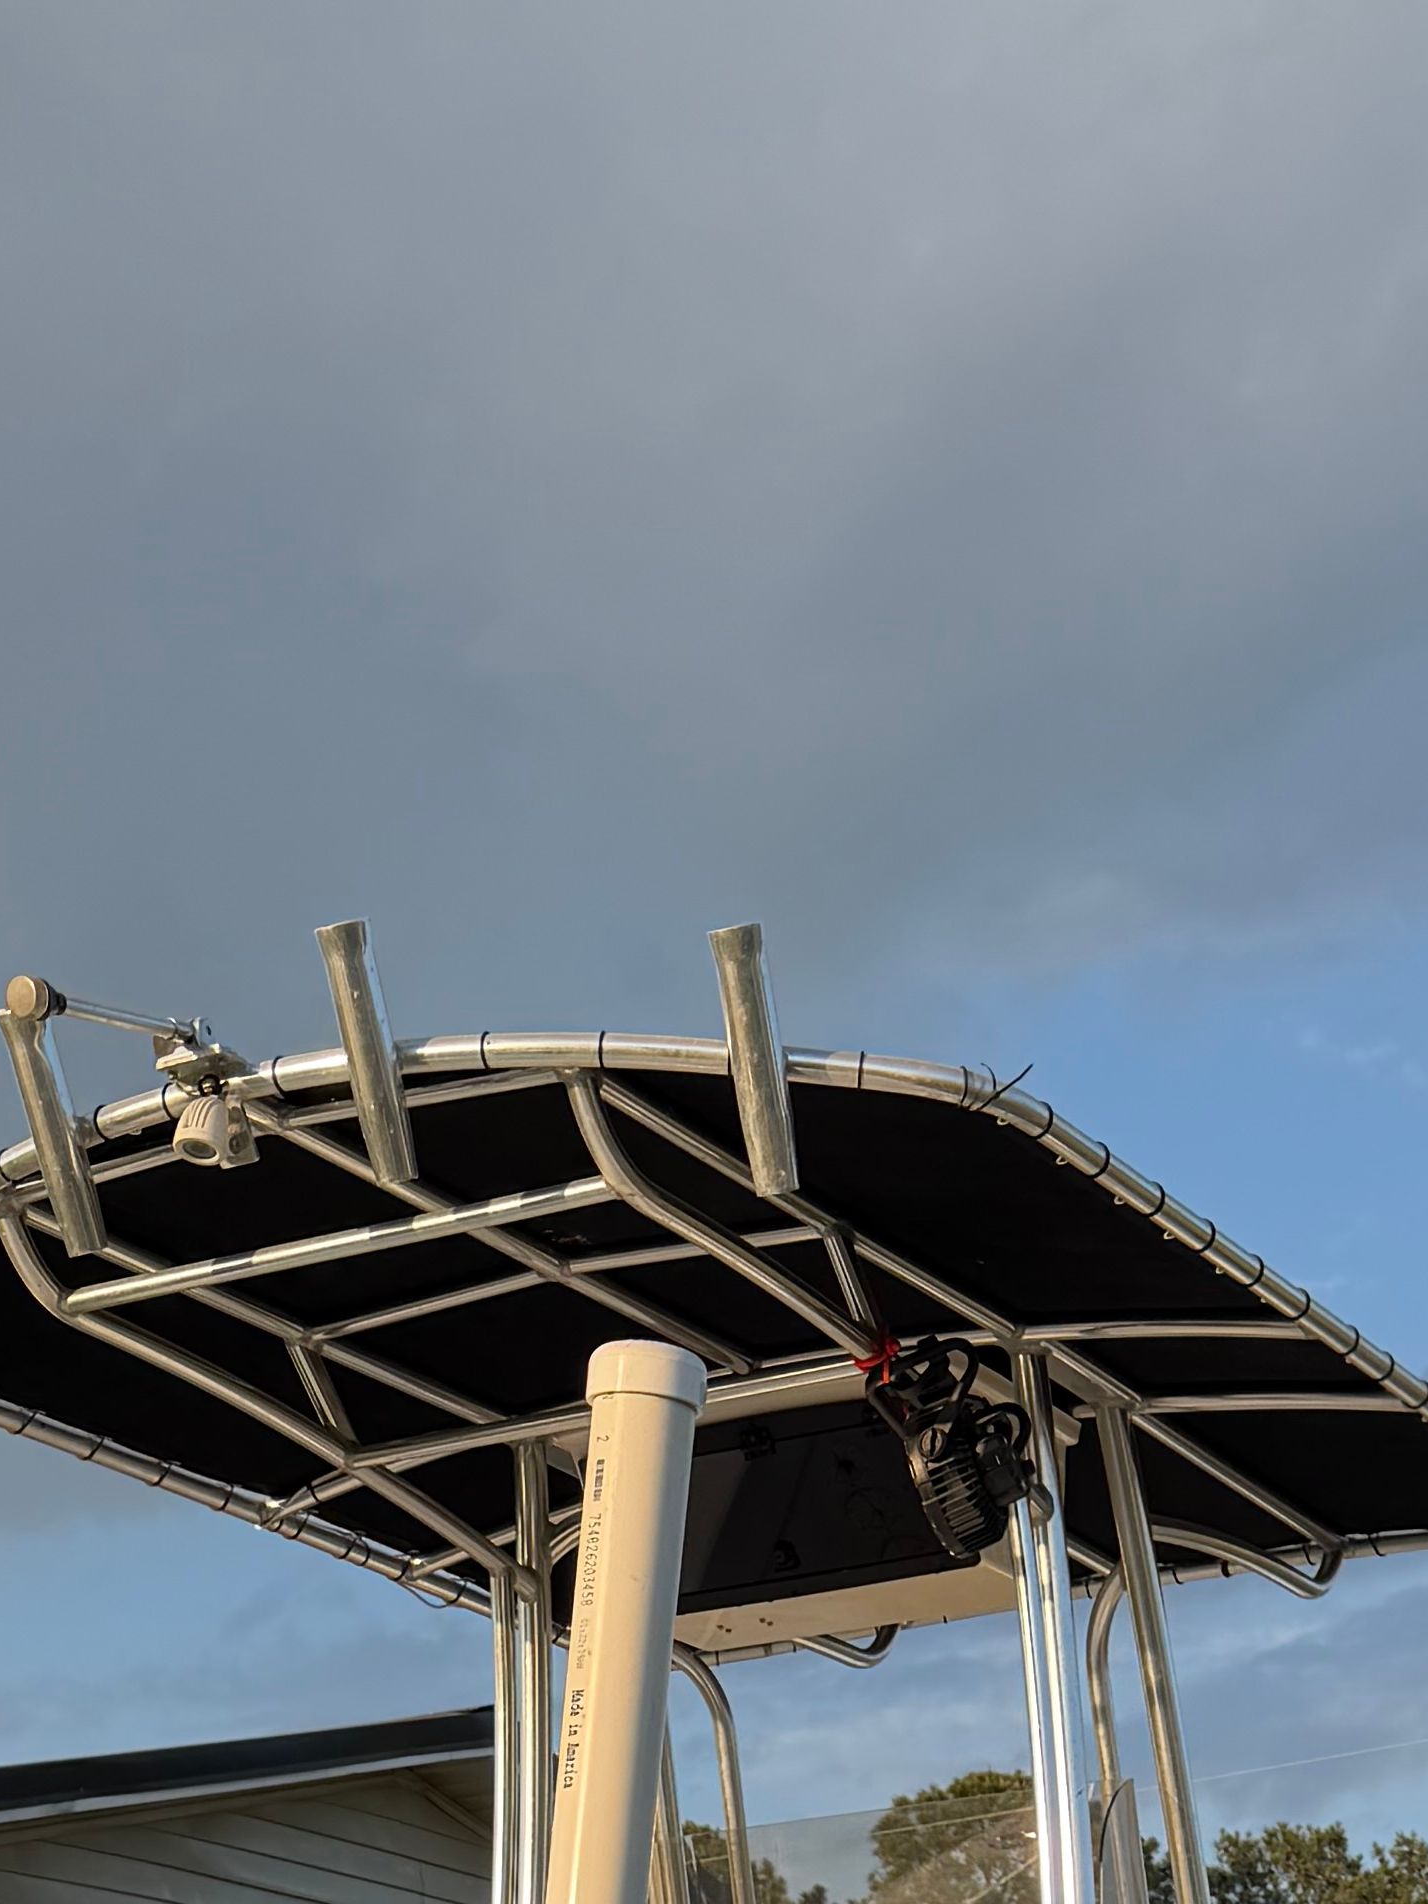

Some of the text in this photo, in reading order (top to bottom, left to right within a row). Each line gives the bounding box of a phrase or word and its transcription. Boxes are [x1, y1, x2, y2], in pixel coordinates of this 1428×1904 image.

[569, 1688, 586, 1719] Made
[568, 1723, 582, 1738] in
[562, 1741, 581, 1790] America
